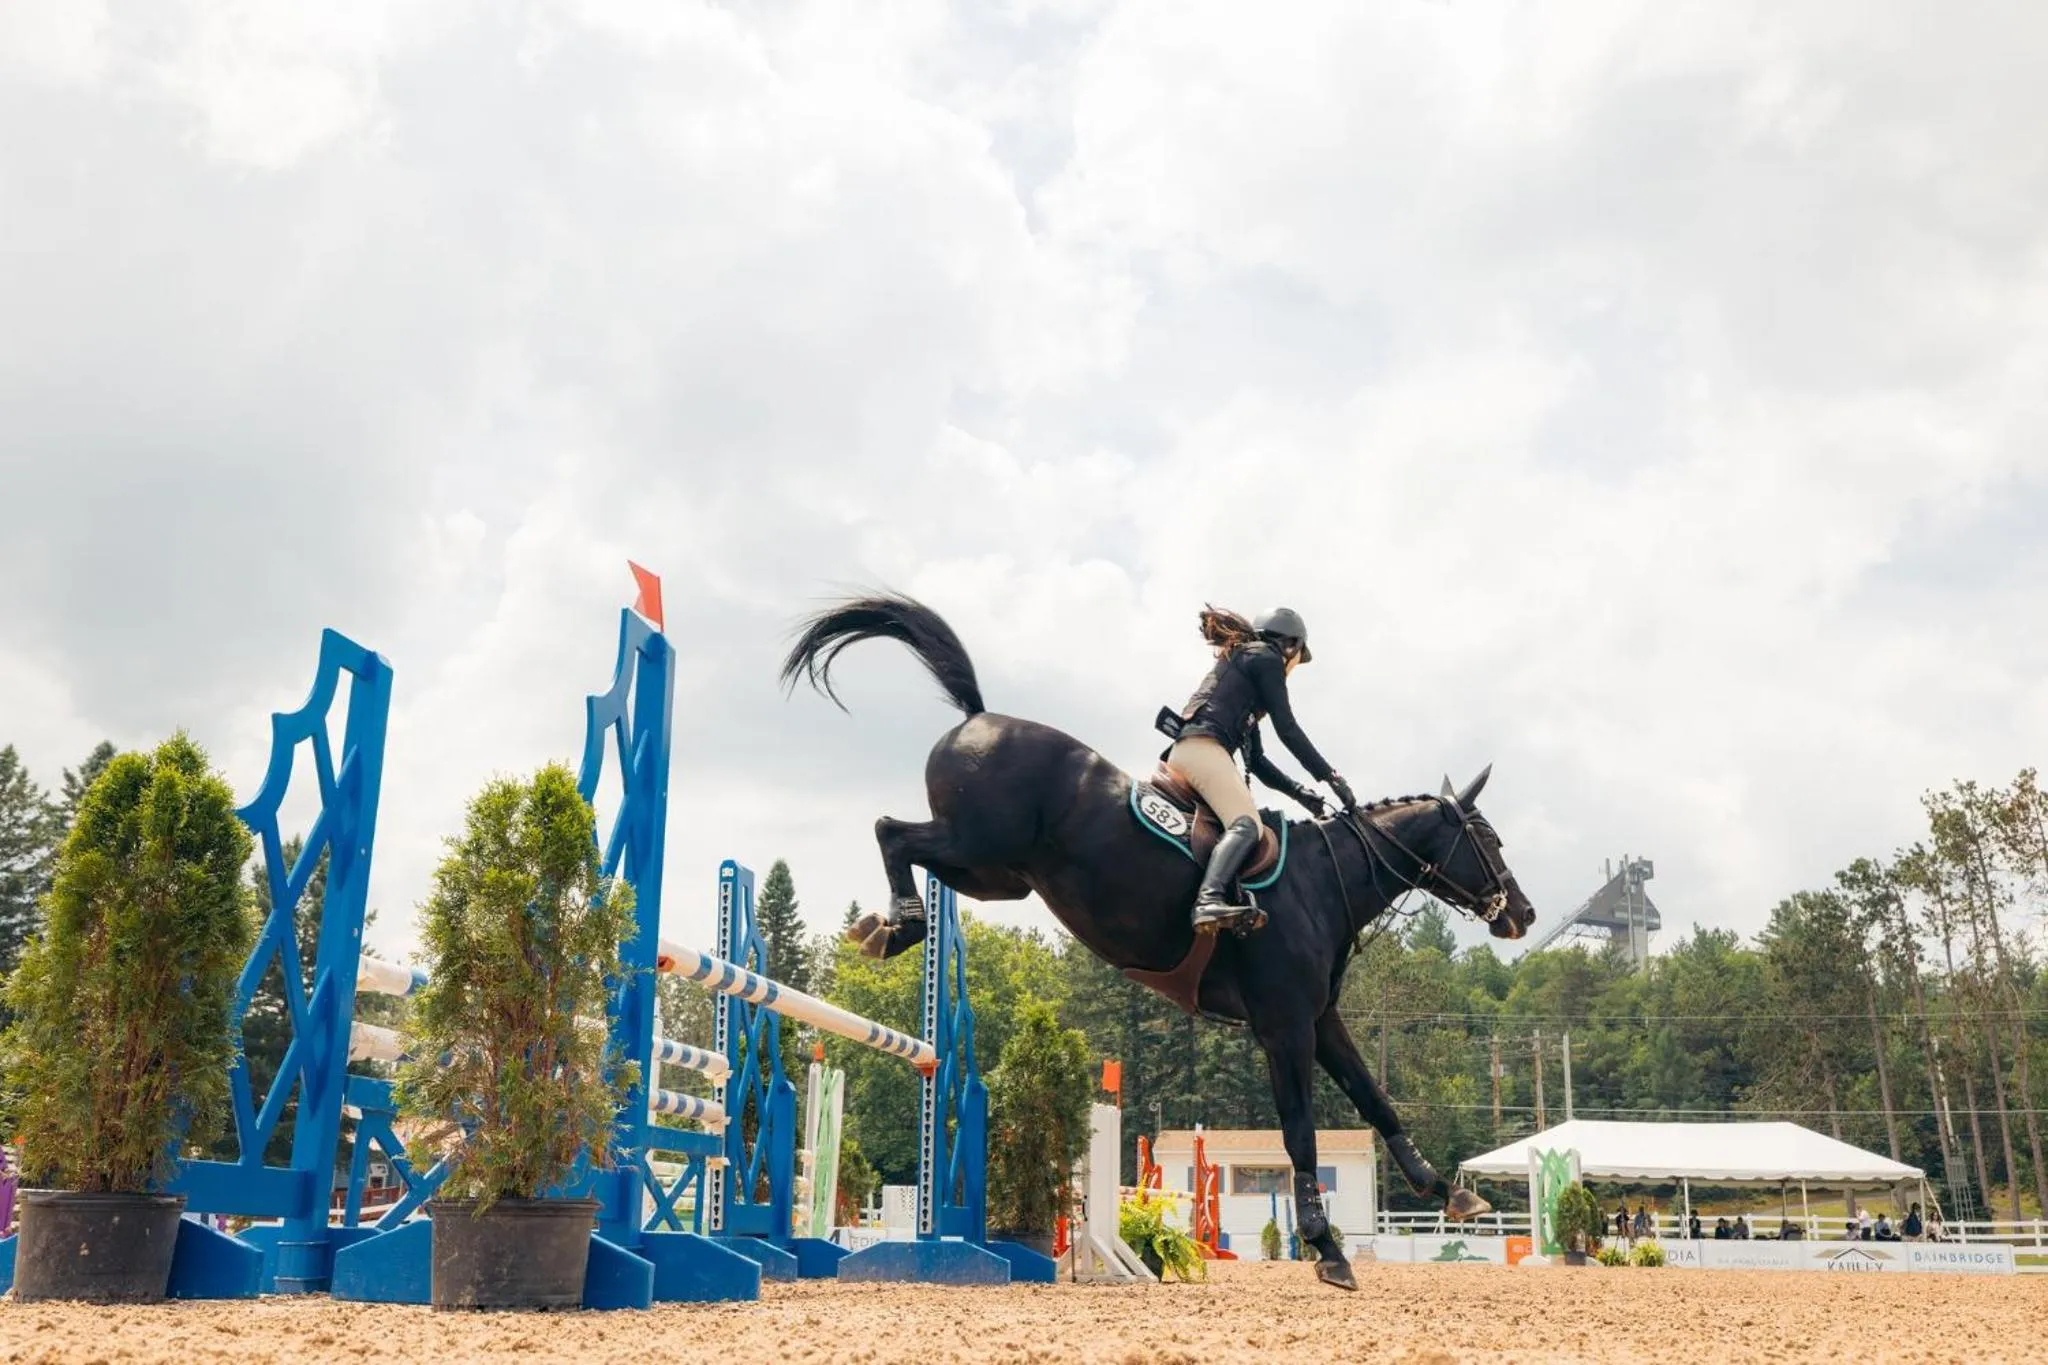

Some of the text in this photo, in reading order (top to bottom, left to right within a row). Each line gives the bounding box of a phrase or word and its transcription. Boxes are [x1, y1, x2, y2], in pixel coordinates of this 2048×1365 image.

[1144, 801, 1182, 829] 587
[1667, 1250, 1696, 1261] DIA
[1914, 1251, 2005, 1264] BAINBRIDGE
